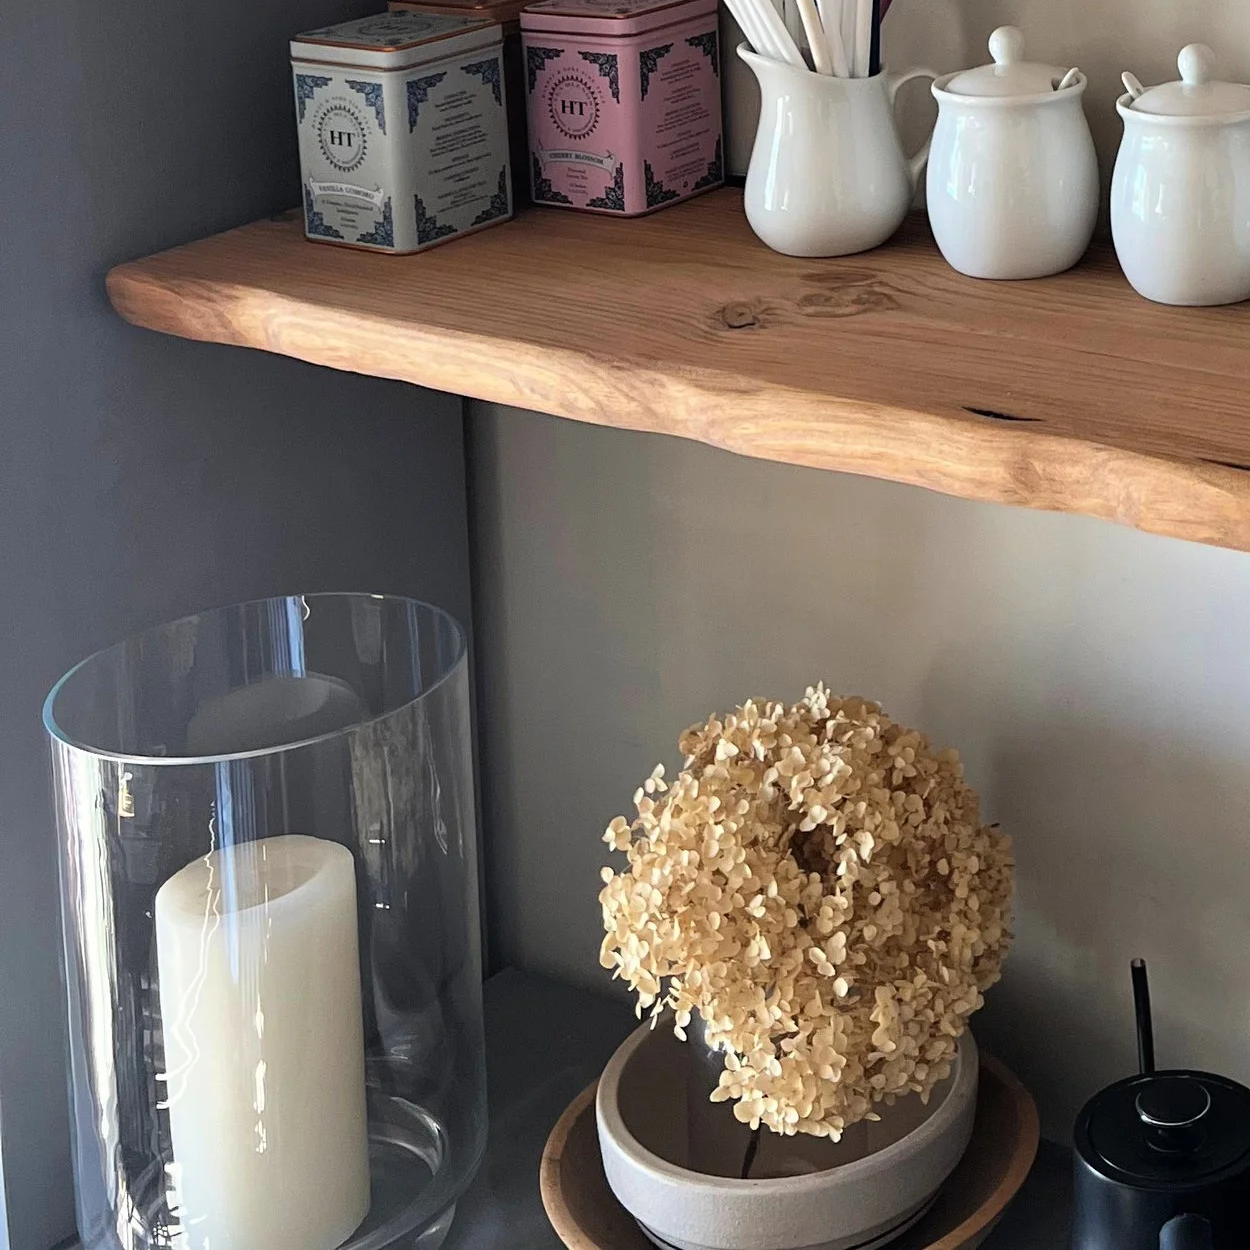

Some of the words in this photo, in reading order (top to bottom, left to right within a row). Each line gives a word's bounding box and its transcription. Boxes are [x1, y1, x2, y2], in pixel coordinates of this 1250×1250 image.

[561, 100, 588, 116] HT
[330, 130, 356, 147] HT
[575, 153, 604, 165] BLOSSOM
